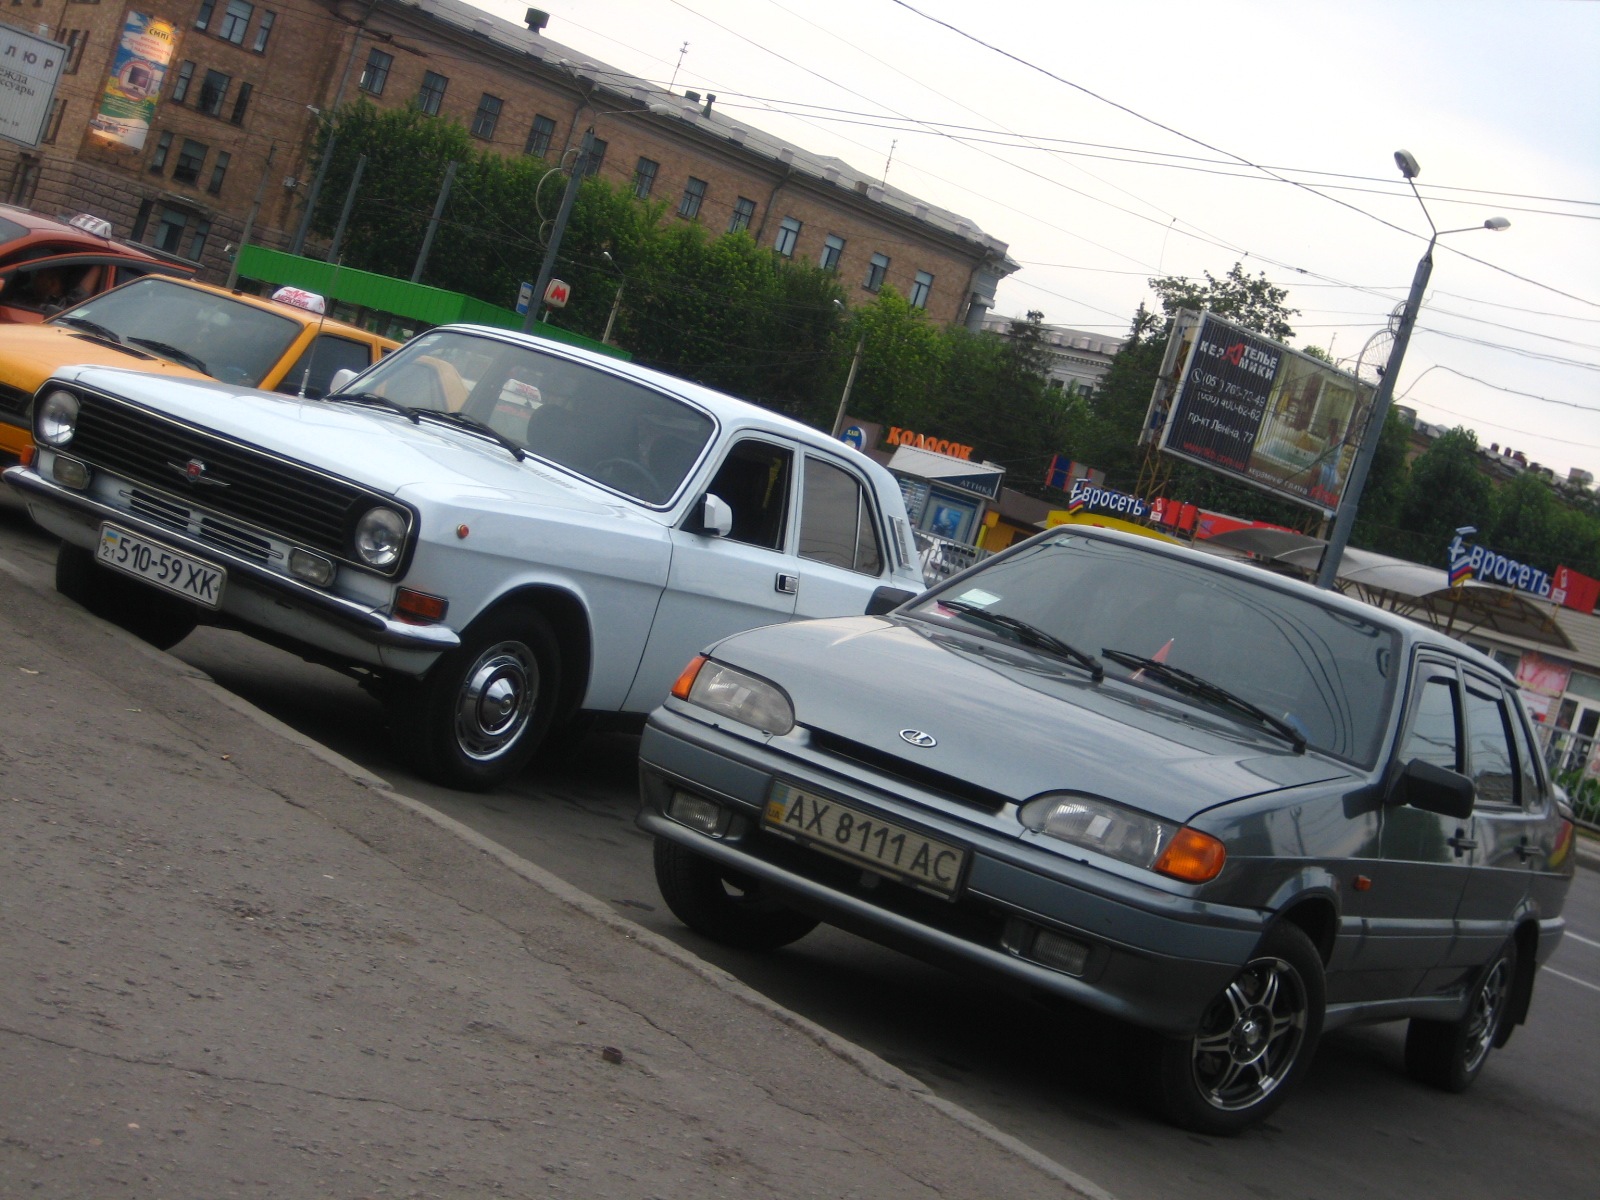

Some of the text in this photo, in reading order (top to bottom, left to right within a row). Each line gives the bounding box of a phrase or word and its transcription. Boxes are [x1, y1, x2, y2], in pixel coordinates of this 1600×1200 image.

[1202, 372, 1224, 392] (05)
[886, 426, 975, 461] КОЛОСОК
[1243, 431, 1254, 443] 77
[117, 537, 183, 584] 510-59
[785, 795, 957, 882] AX 8111 AC
